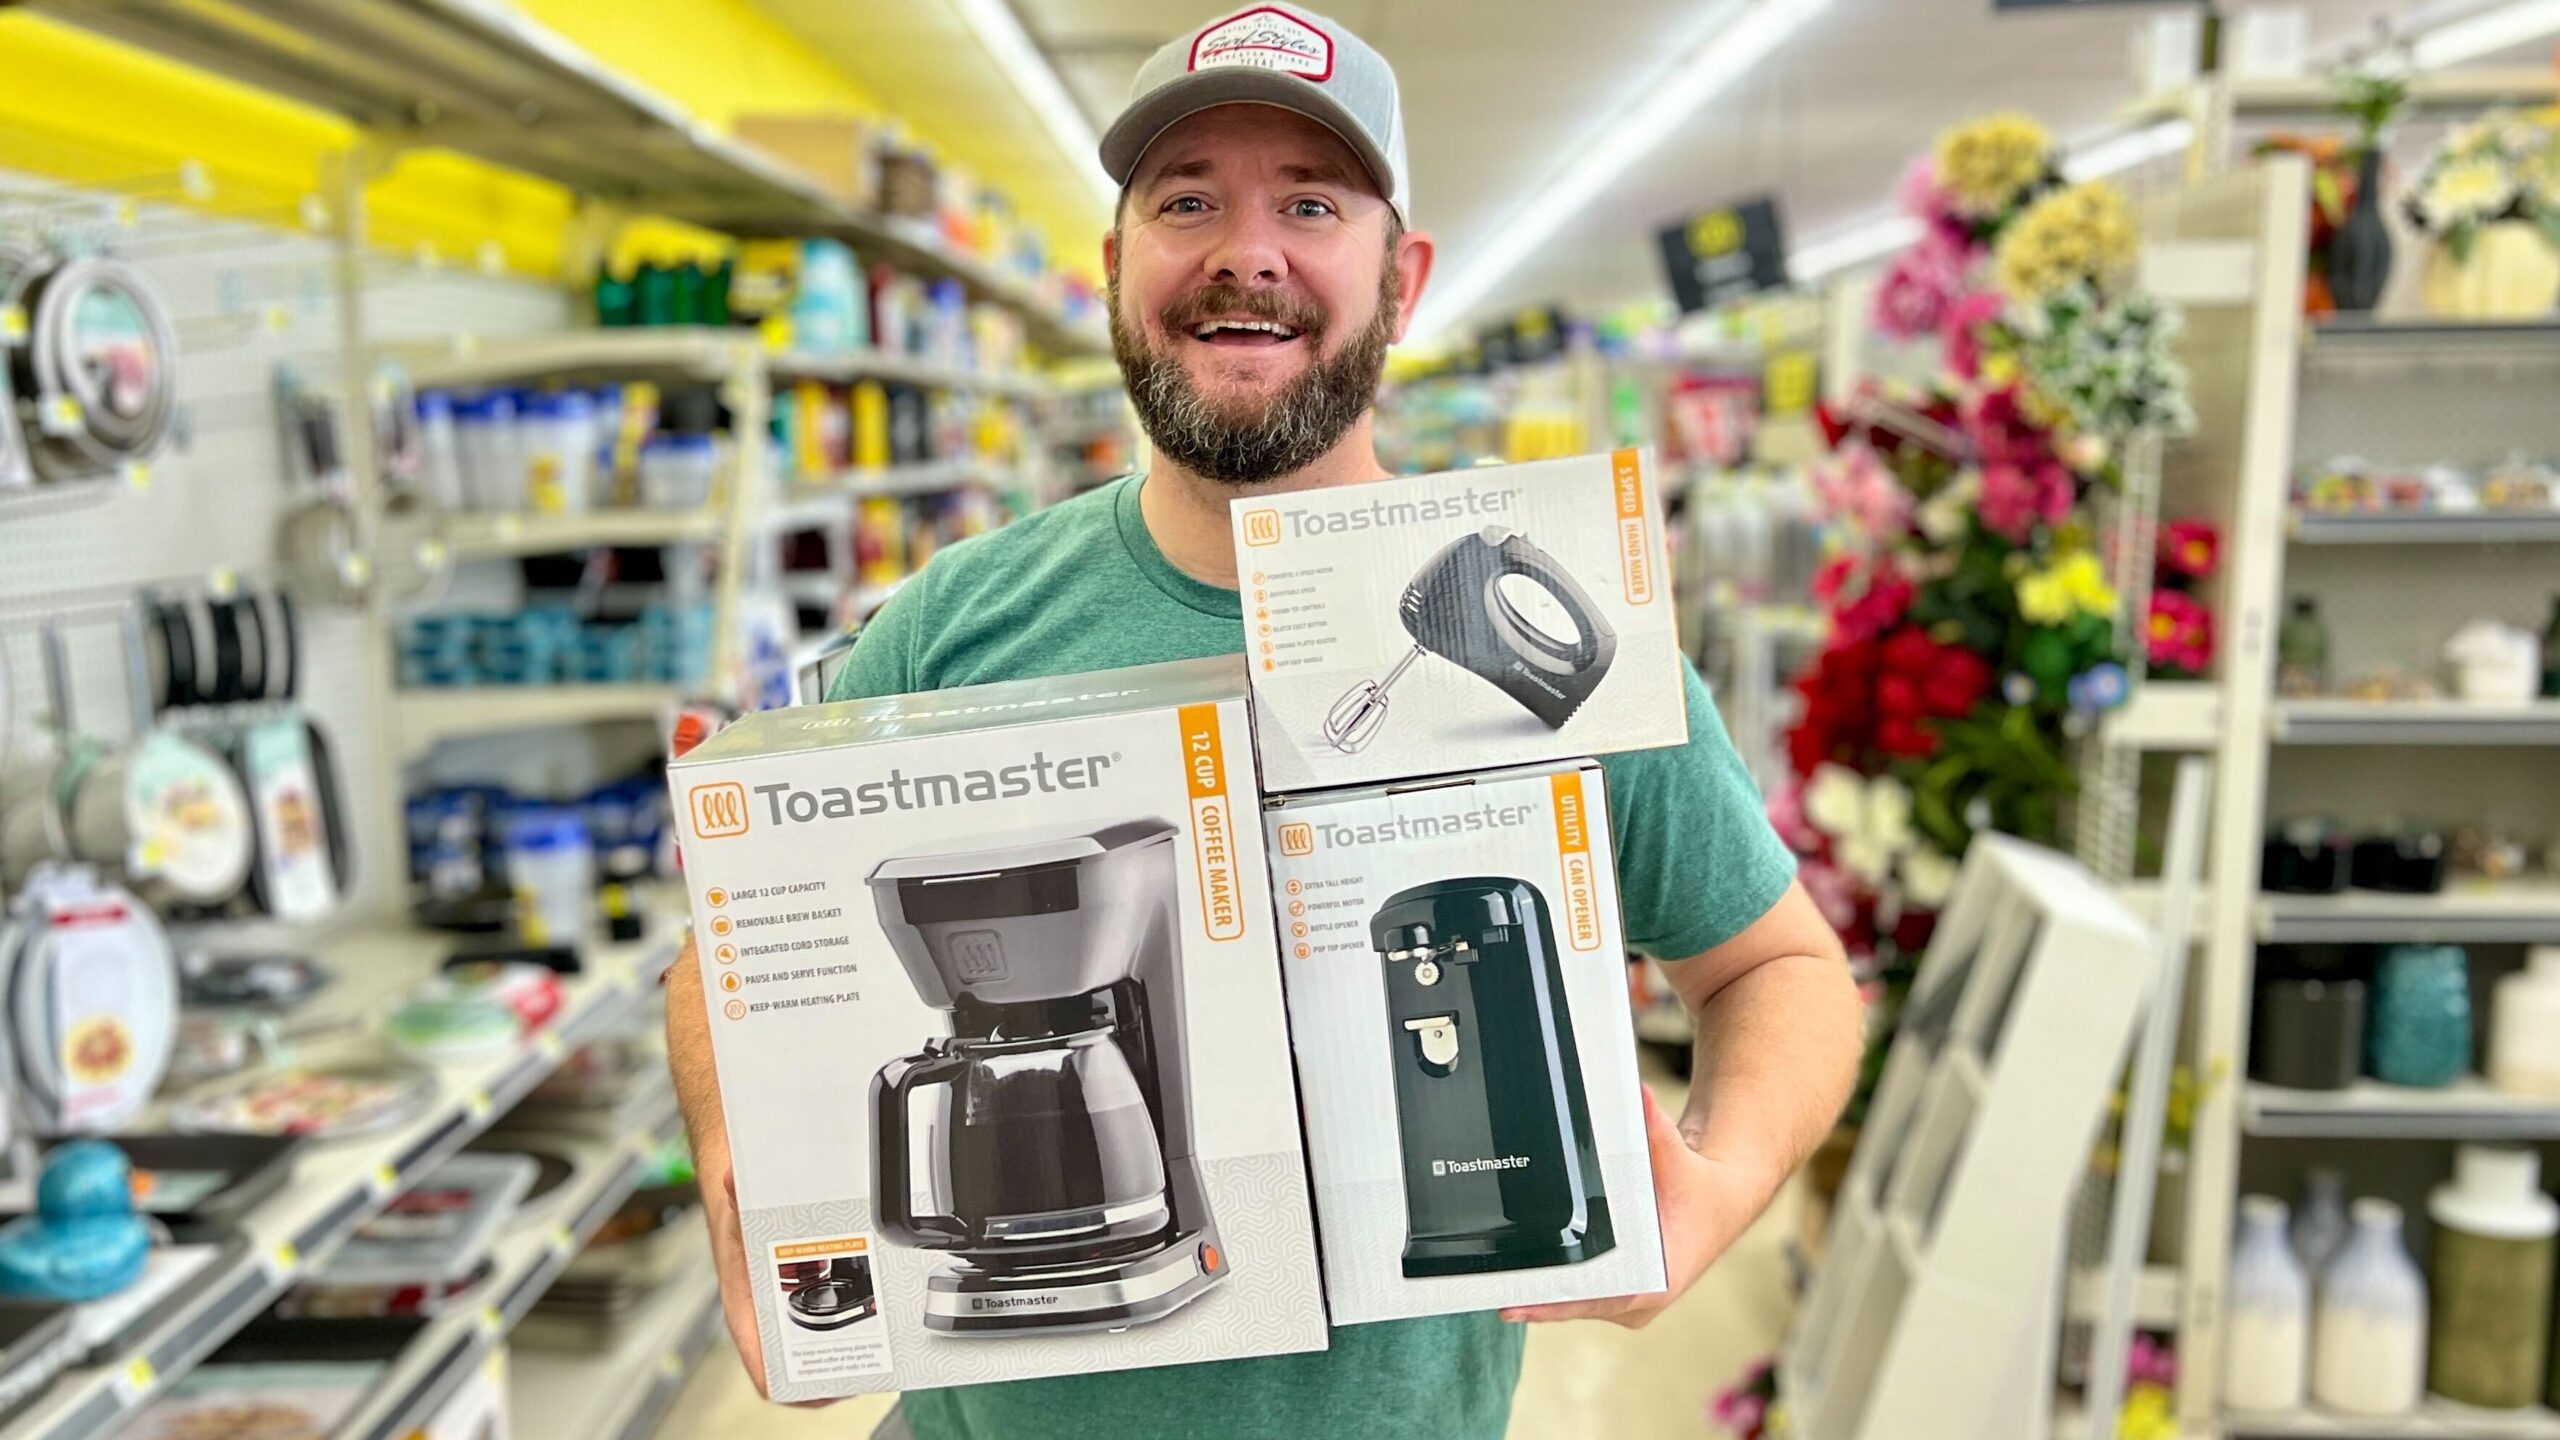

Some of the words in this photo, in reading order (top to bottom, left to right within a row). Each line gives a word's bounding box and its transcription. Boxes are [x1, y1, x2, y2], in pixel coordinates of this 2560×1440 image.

[1241, 58, 1274, 68] TEXAS
[1619, 466, 1633, 475] 5
[1620, 476, 1637, 513] SPEED
[1284, 488, 1516, 538] Toastmaster
[1626, 523, 1641, 558] HAND
[1630, 559, 1645, 595] MIXER
[1522, 665, 1567, 700] Toastmaster
[858, 687, 1141, 724] Toastmaster
[1191, 730, 1211, 752] 12
[1194, 755, 1217, 789] CUP
[1201, 805, 1225, 864] COFFEE
[1317, 803, 1531, 849] Toastmaster
[1560, 795, 1582, 847] UTILITY
[1568, 858, 1585, 885] CAN
[731, 888, 758, 901] LARGE
[759, 887, 770, 898] 12
[770, 885, 787, 897] CUP
[788, 881, 826, 894] CAPACITY
[1209, 868, 1233, 927] MAKER
[736, 915, 785, 929] REMOVABLE
[786, 912, 810, 923] BREW
[811, 907, 842, 920] BASKET
[1572, 888, 1593, 941] OPENER
[740, 943, 790, 957] INTEGRATED
[791, 940, 813, 951] CORD
[813, 935, 850, 949] STORAGE
[745, 973, 771, 985] PAUSE
[772, 971, 790, 982] AND
[790, 968, 816, 980] SERVE
[816, 963, 858, 977] FUNCTION
[750, 999, 799, 1013] KEEP-WARM
[800, 995, 835, 1008] HEATING
[836, 991, 861, 1003] PLATE
[1447, 1155, 1531, 1174] Toastmaster
[984, 1295, 1059, 1309] Toastmaster
